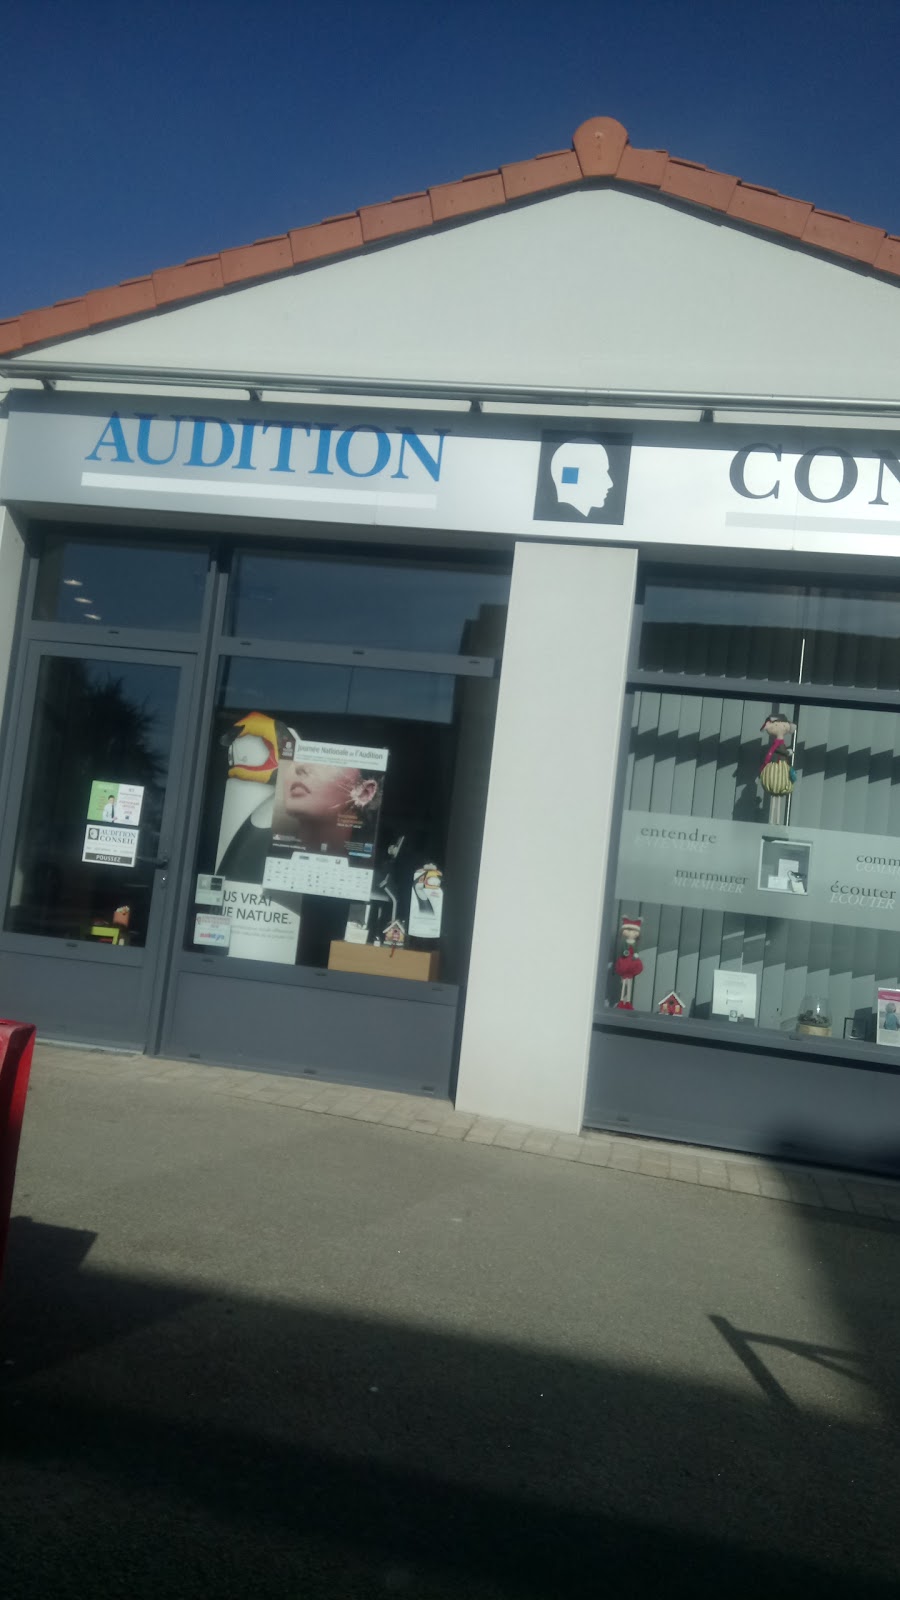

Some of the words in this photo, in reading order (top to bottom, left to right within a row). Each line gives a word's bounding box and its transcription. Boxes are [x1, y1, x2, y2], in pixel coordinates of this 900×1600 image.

[84, 410, 452, 482] AUDITION
[99, 835, 135, 845] CONSEIL
[100, 829, 137, 838] AUDITION
[640, 827, 717, 844] entendre
[96, 855, 122, 863] POUSSEZ
[675, 869, 749, 885] murmurer
[830, 880, 896, 899] écouter
[223, 890, 237, 903] US
[241, 892, 273, 907] VRAI
[236, 908, 292, 925] NATURE.
